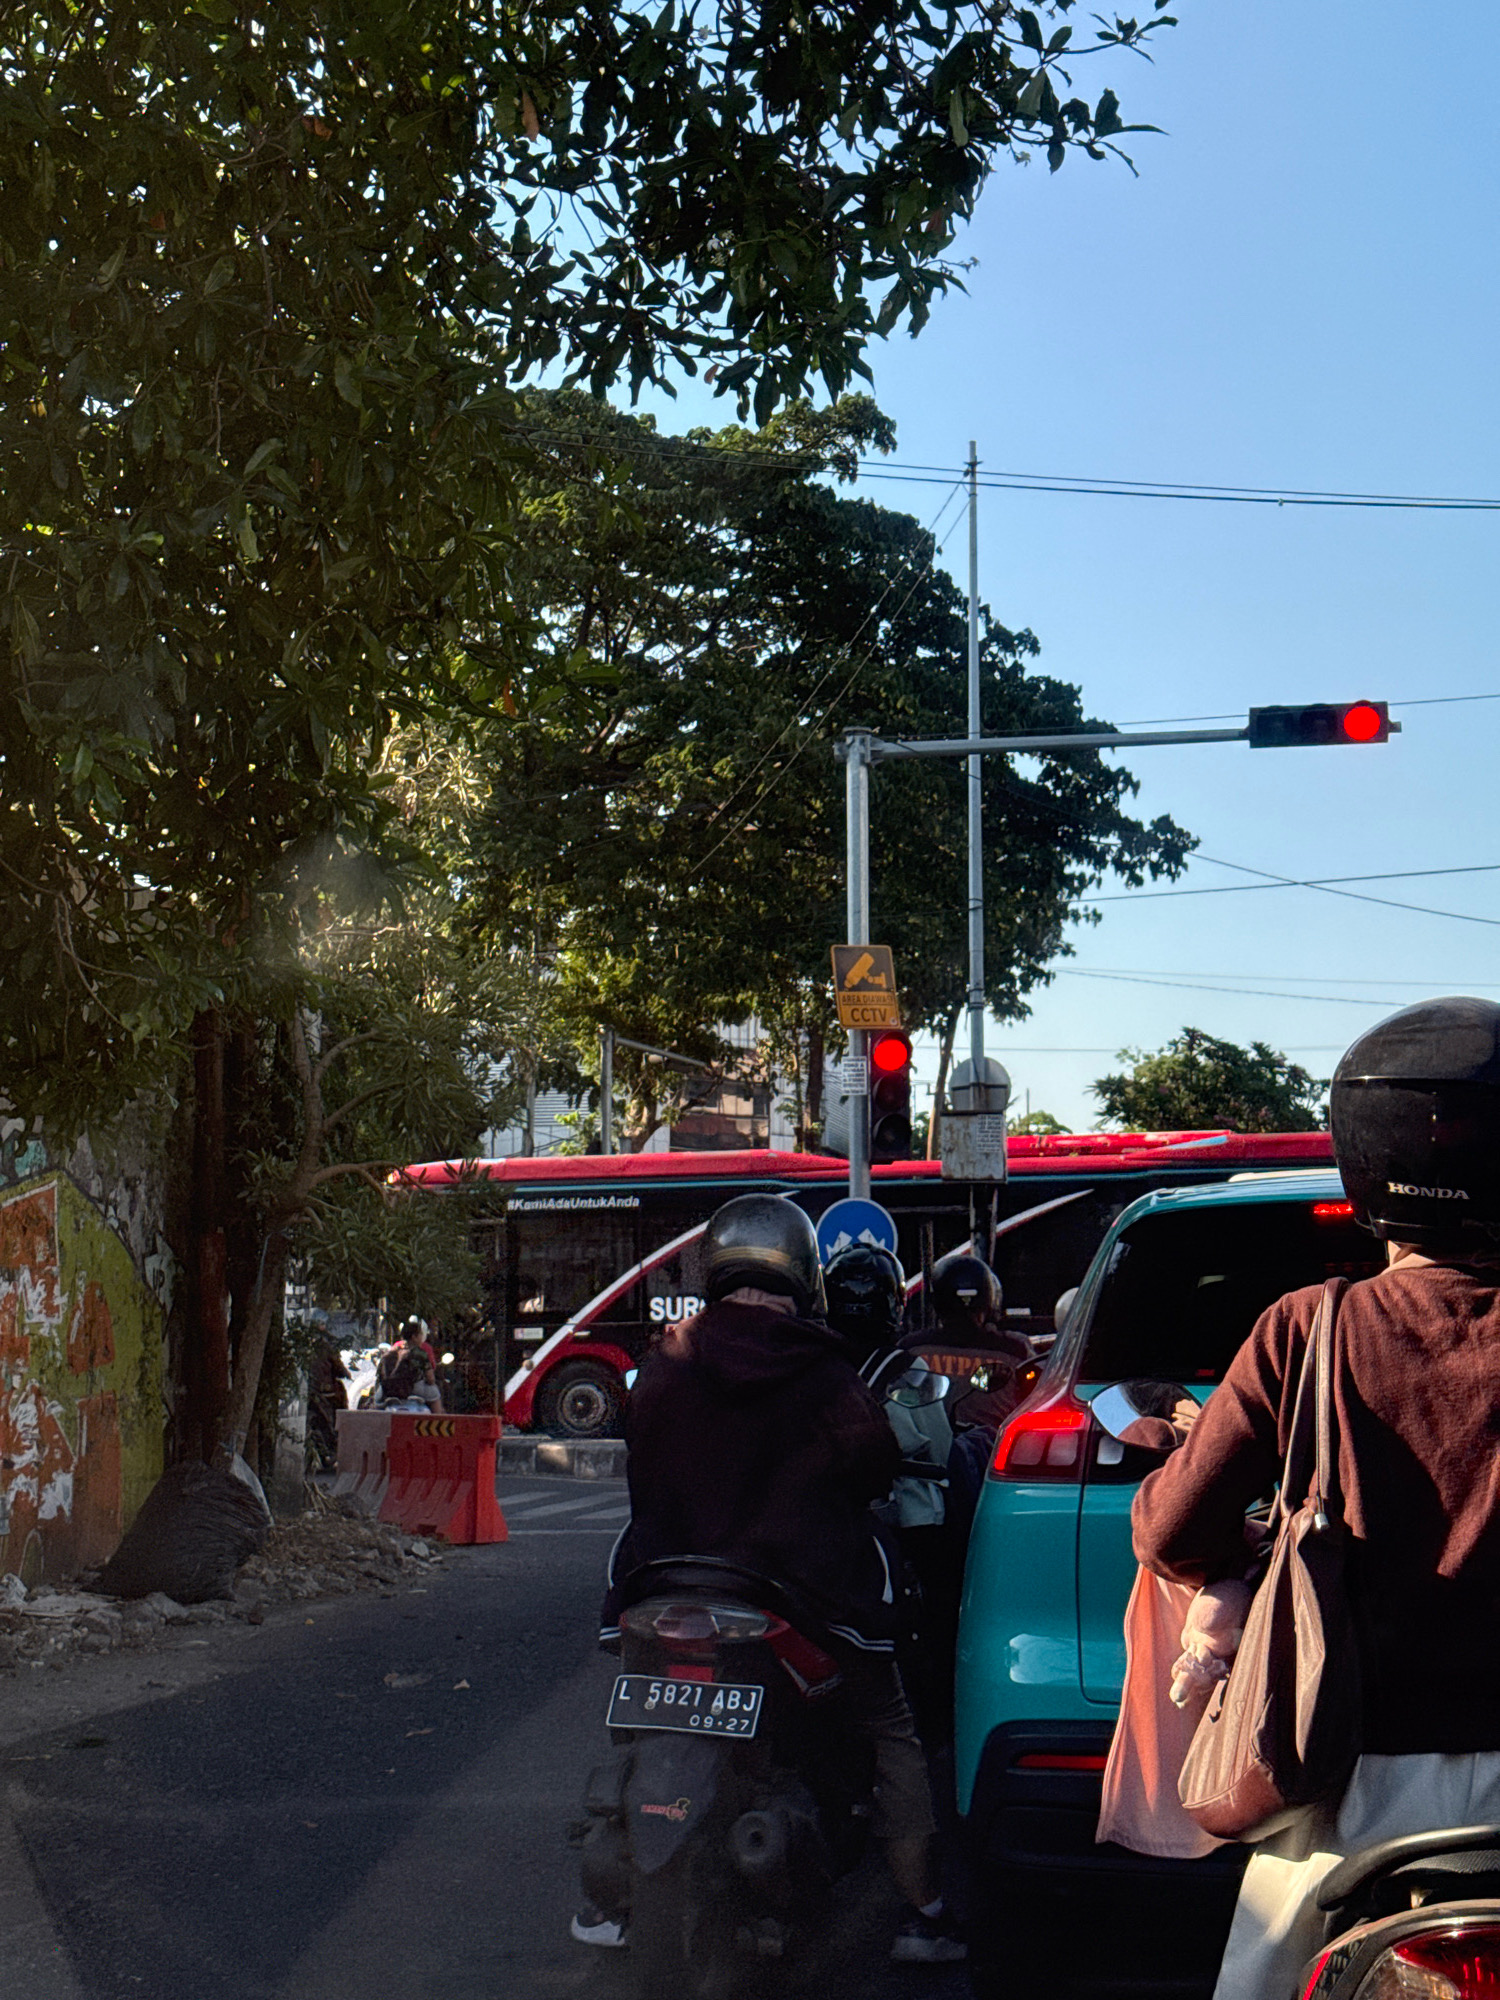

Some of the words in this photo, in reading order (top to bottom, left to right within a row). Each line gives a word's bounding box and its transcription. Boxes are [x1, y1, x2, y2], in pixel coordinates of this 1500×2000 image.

[851, 1007, 887, 1022] CCTV
[1387, 1181, 1470, 1200] HONDA
[507, 1195, 640, 1211] #KamiAdaUntukAnda
[649, 1296, 706, 1321] SUR
[920, 1353, 1004, 1376] ATPA
[618, 1680, 631, 1700] L
[646, 1682, 703, 1707] 5821
[711, 1689, 757, 1713] ABJ
